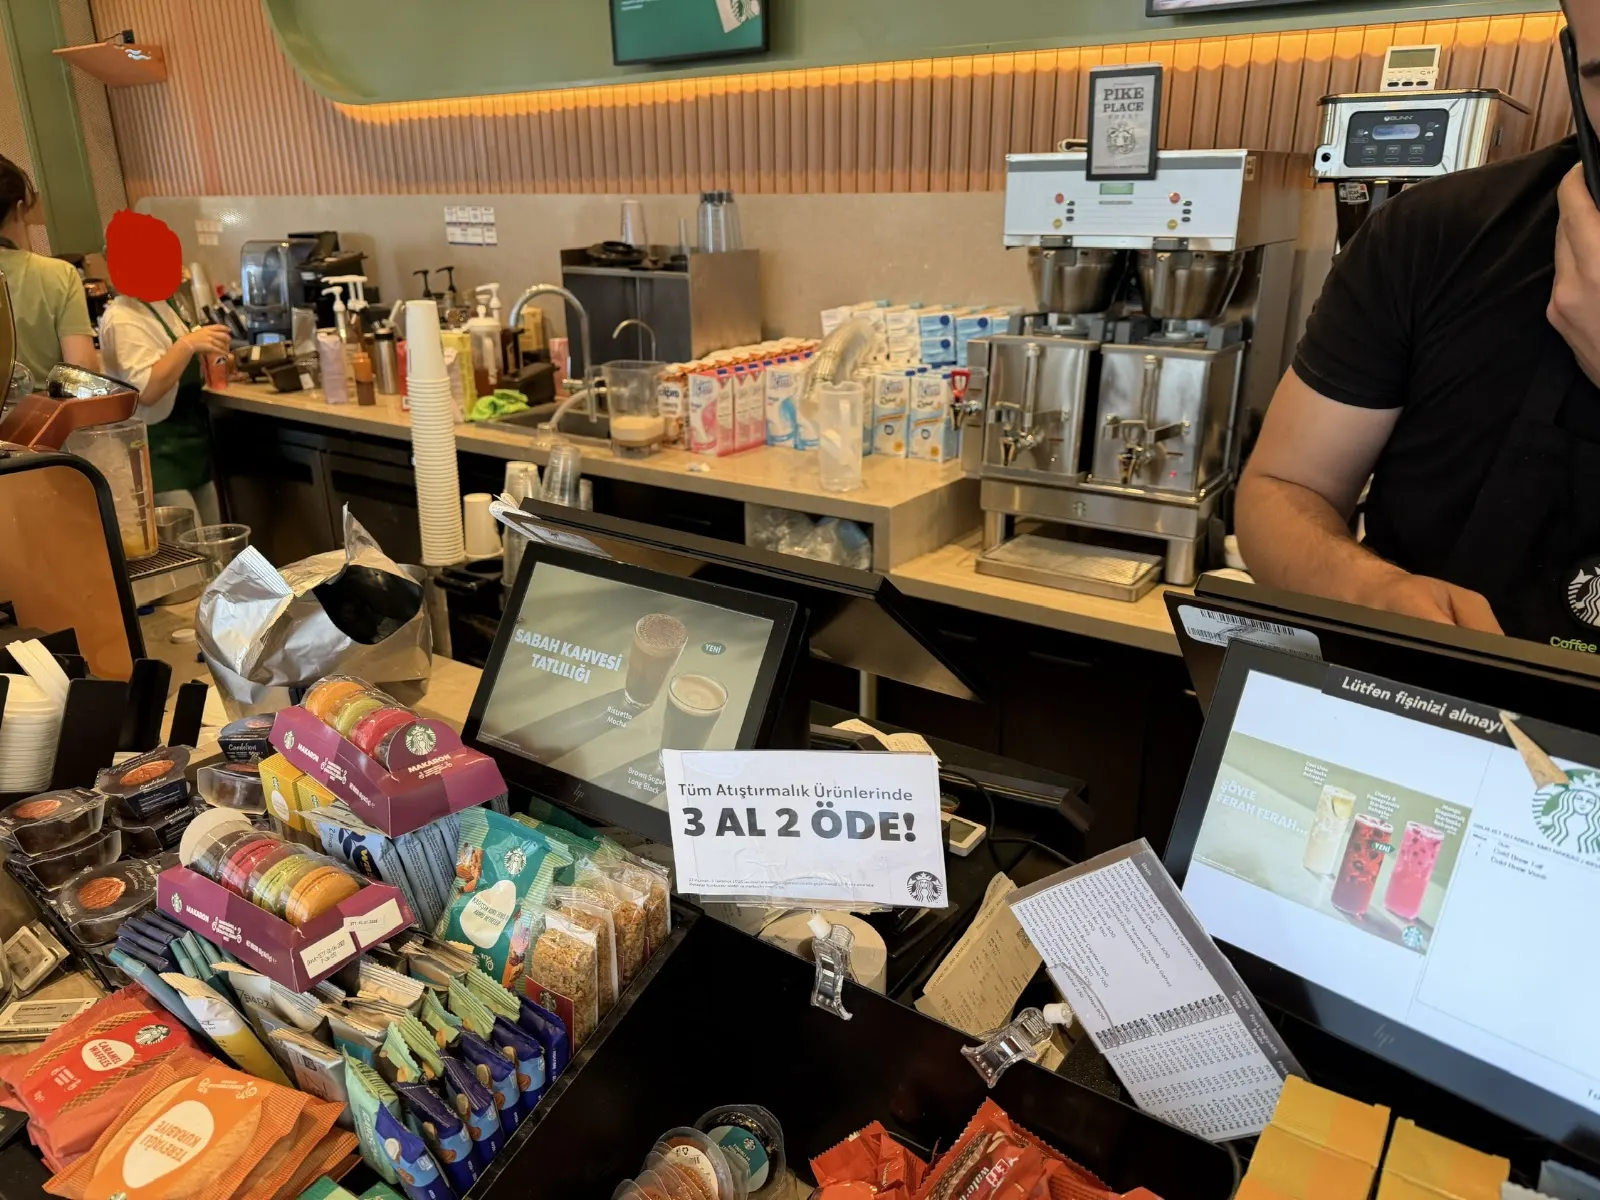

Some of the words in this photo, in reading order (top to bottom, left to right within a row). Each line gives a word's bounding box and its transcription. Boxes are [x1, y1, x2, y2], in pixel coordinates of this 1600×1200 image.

[1103, 87, 1145, 101] PIKE
[1103, 102, 1144, 113] PLACE
[514, 629, 561, 654] SABAH
[561, 643, 623, 671] KAHVESİ
[705, 643, 722, 654] YENİ
[1549, 636, 1597, 653] Coffee
[531, 653, 592, 684] TATLILIĞI
[1341, 675, 1392, 701] Lütfen
[1395, 690, 1447, 718] fişinizi
[606, 705, 632, 721] Ristretto
[606, 716, 627, 729] Mocha
[295, 741, 320, 763] MAKARON
[407, 753, 451, 772] MAKARON
[627, 767, 647, 781] Brown
[646, 772, 666, 786] Sugar
[627, 776, 643, 790] Long
[642, 781, 660, 795] Black
[678, 783, 712, 797] Tüm
[716, 783, 810, 800] Atıştırmalık
[814, 782, 913, 801] Ürünlerinde
[1216, 794, 1258, 819] FERAH
[682, 807, 706, 837] 3
[715, 807, 766, 837] AL
[775, 807, 801, 838] 2
[810, 801, 917, 842] ÖDE!
[1374, 842, 1391, 853] YENİ
[184, 905, 210, 922] MAKARON
[88, 1045, 111, 1068] WAFFLES
[98, 1040, 122, 1064] CARAMEL
[154, 1120, 201, 1148] KURABİYE
[139, 1133, 187, 1162] TEREYAĞLI
